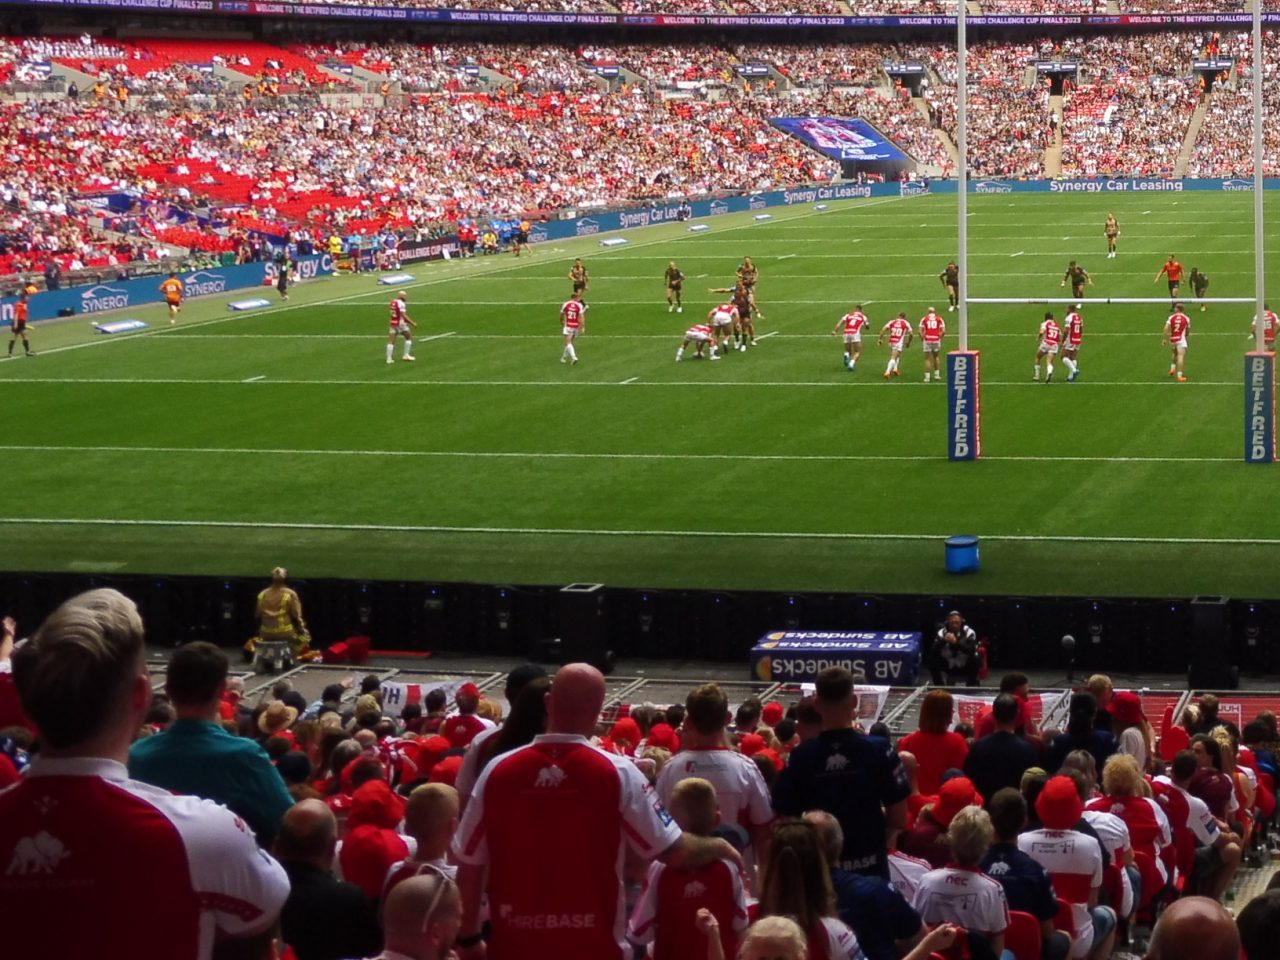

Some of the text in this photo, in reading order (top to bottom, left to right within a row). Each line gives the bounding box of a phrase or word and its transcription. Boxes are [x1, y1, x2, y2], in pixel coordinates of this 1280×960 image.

[160, 0, 172, 8] CUP
[173, 0, 195, 9] FINALS
[197, 1, 213, 10] 2023
[451, 12, 616, 23] WELCOME TO THE BETFRED CHALLENGE CUP FINALS 2023
[1050, 180, 1183, 192] Synergy Car Leasing
[784, 185, 870, 204] Synergy Car Leasing
[620, 212, 650, 228] Synergy
[651, 210, 664, 222] Car
[399, 247, 430, 260] CHALLENGE
[186, 280, 226, 296] SYNERGY
[82, 294, 128, 313] SYNERGY
[927, 320, 938, 328] 10
[891, 328, 902, 336] 20
[954, 356, 968, 457] BETFRED
[1252, 358, 1266, 460] BETFRED
[784, 632, 878, 640] Sundecks
[874, 660, 902, 678] AB
[945, 876, 968, 886] nec
[506, 912, 595, 930] HIREBASE
